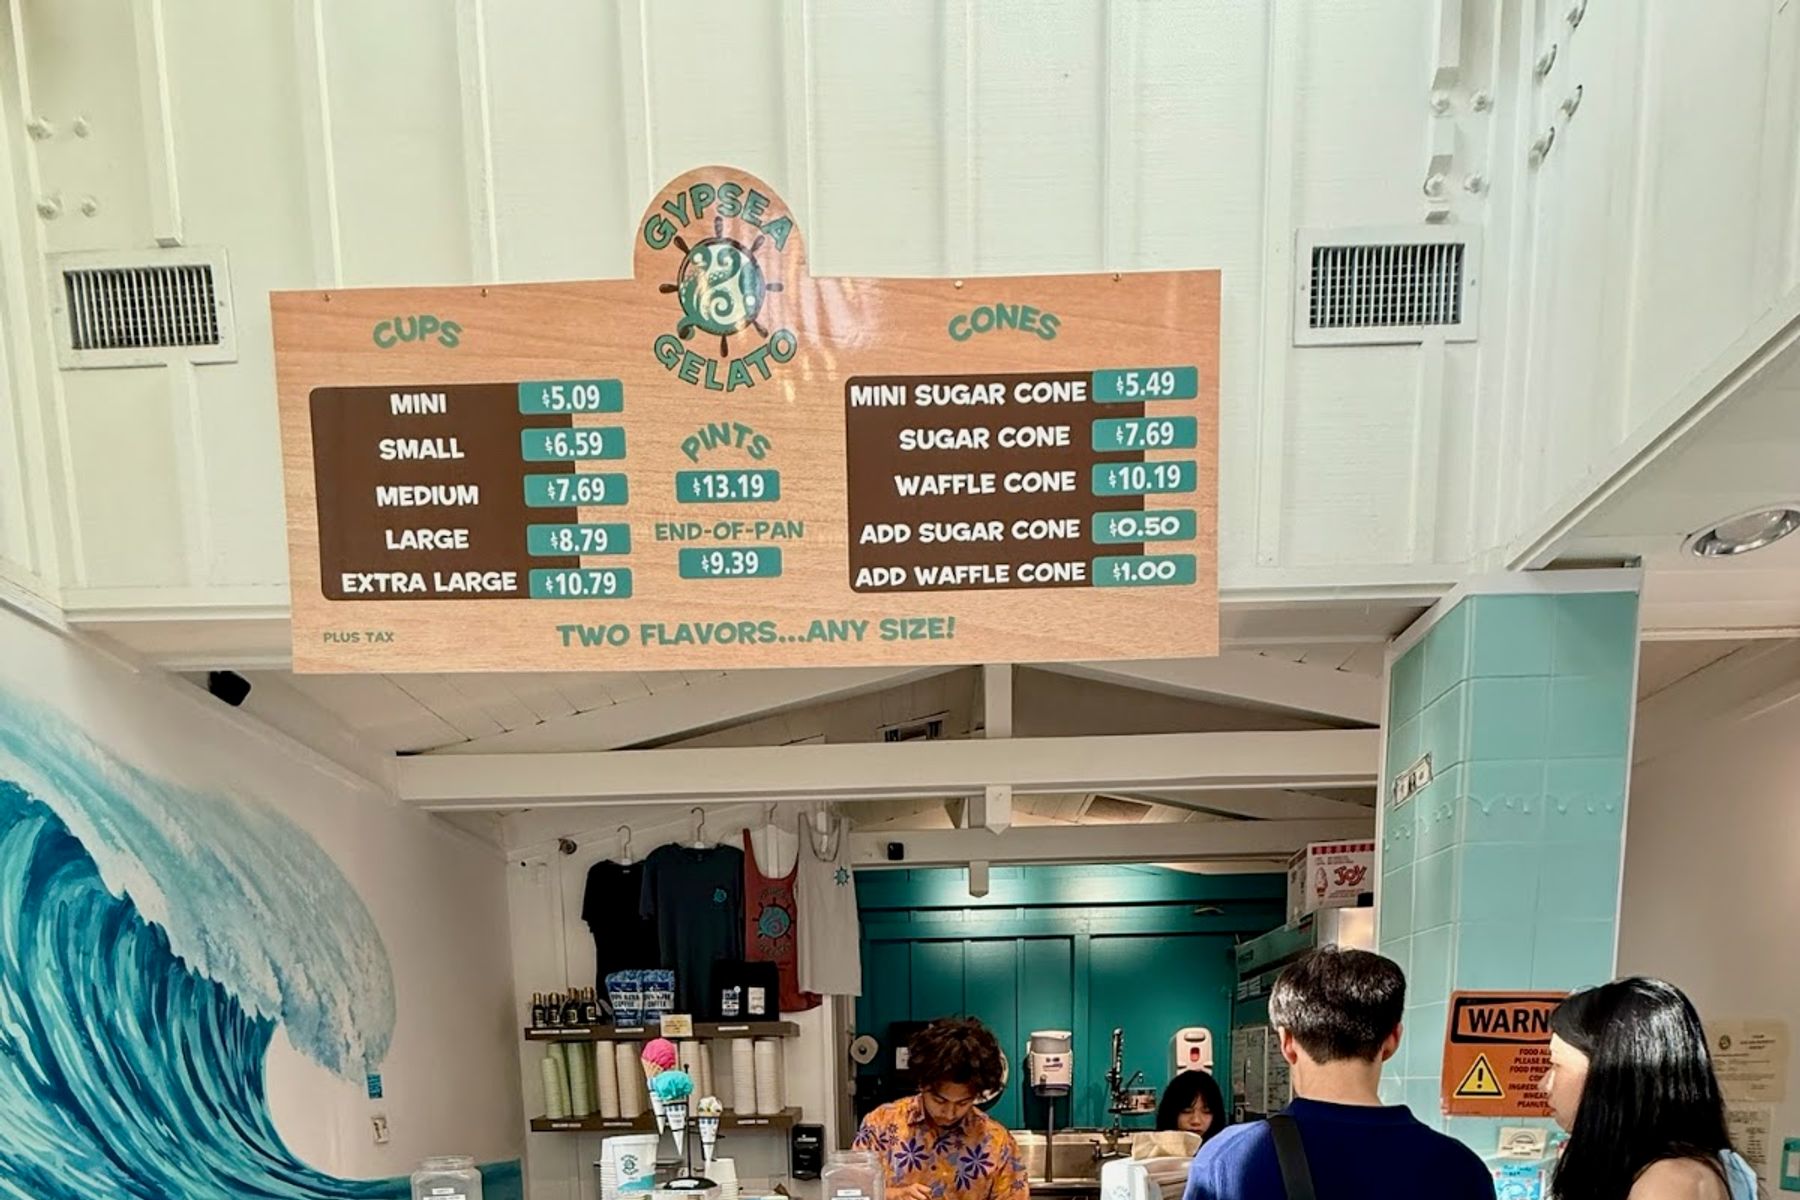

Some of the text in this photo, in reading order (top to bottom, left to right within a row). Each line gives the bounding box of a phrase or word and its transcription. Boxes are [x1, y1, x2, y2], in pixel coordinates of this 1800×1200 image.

[644, 182, 793, 252] GYPSEA
[373, 314, 463, 347] CUPS
[948, 303, 1061, 341] CONES
[653, 329, 798, 392] GELATO
[390, 385, 600, 415] MINI $5.09
[850, 371, 1175, 408] MINI SUGAR CONE $5.49
[378, 431, 603, 461] SMALL $6.59
[680, 421, 772, 463] PINTS
[898, 421, 1174, 451] SUGAR CONE $7.69
[375, 476, 605, 508] MEDIUM $7.69
[693, 472, 765, 500] $13.19
[893, 464, 1181, 497] WAFFLE CONE $10.19
[385, 527, 608, 554] LARGE $8.79
[655, 520, 804, 542] END-OF-PAN
[859, 515, 1181, 545] ADD SUGAR CONE $0.50
[701, 550, 759, 577] $9.39
[854, 560, 1177, 588] ADD WAFFLE CONE $1.00
[341, 570, 617, 597] EXTRA LARGE $10.79
[322, 631, 395, 644] PLUS TAX
[556, 624, 630, 648] TWO
[879, 616, 956, 641] SIZE!
[1468, 1008, 1550, 1034] WARN
